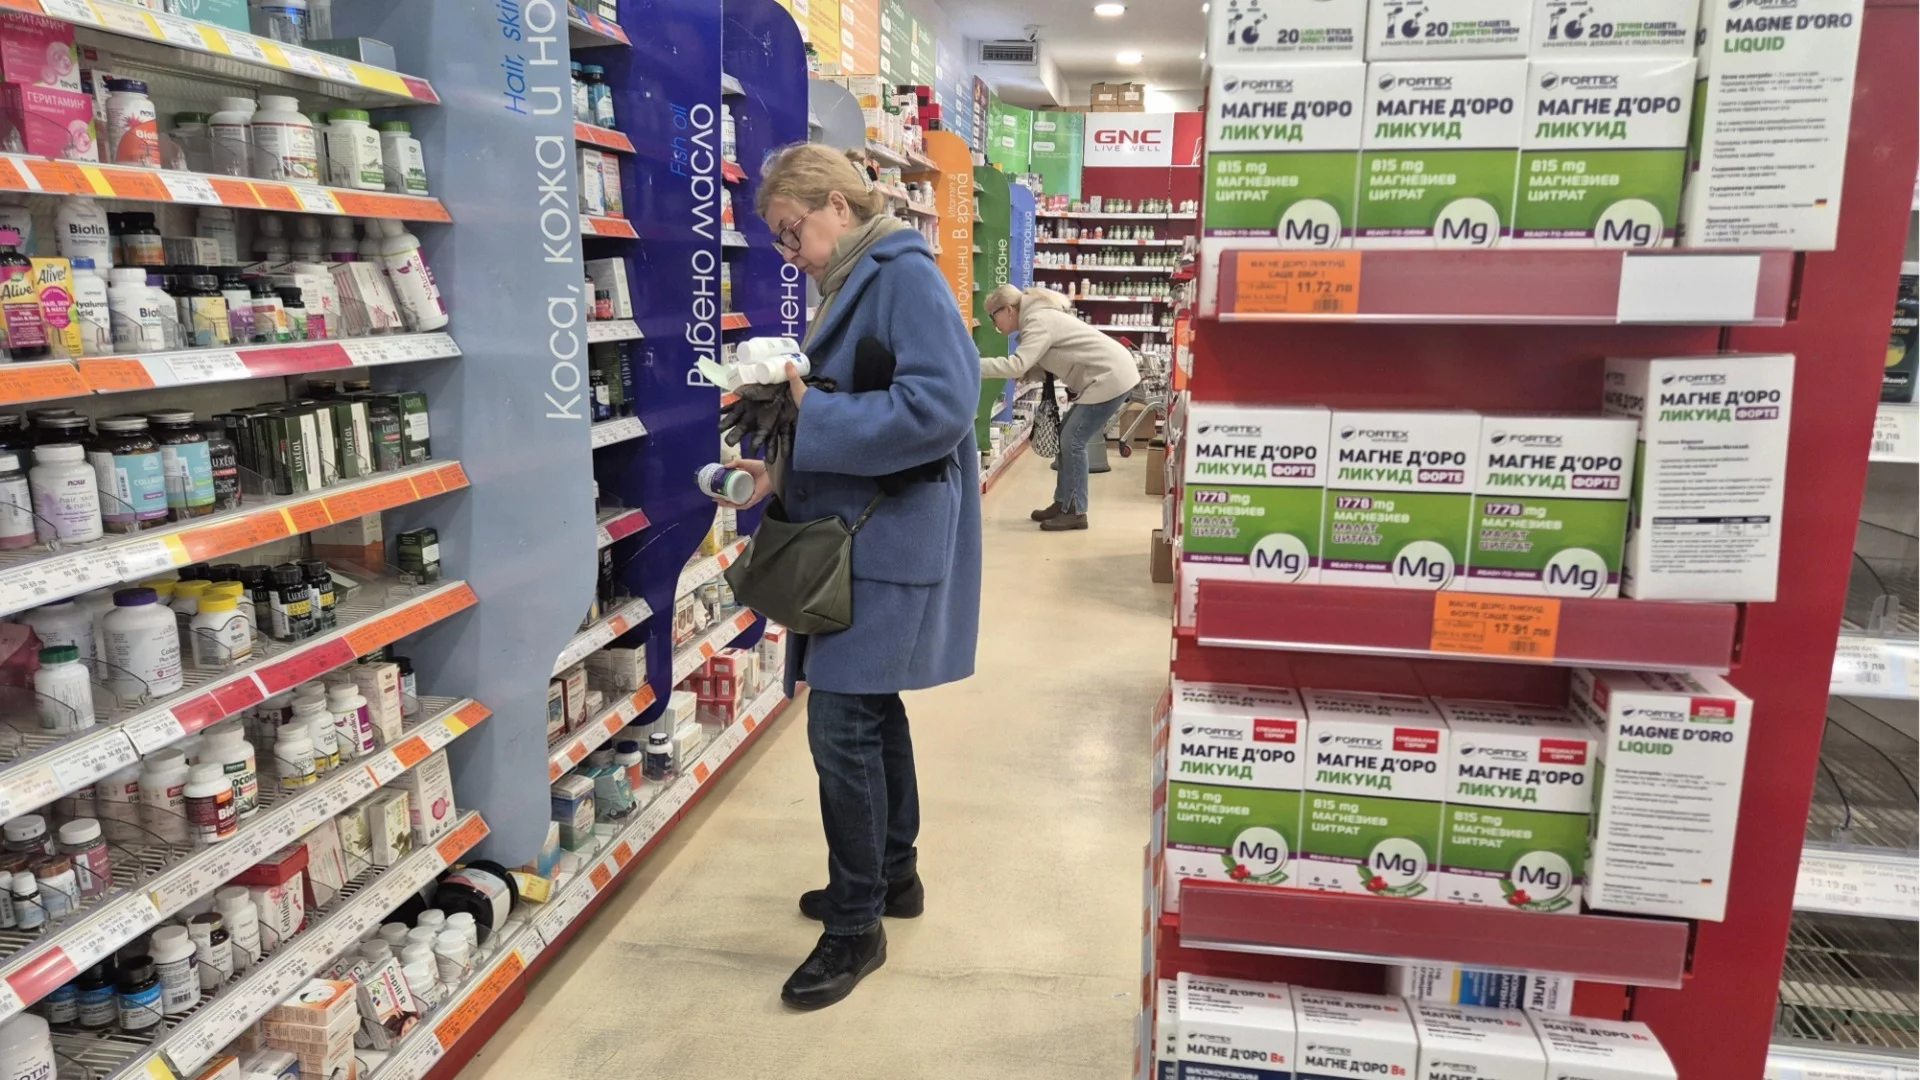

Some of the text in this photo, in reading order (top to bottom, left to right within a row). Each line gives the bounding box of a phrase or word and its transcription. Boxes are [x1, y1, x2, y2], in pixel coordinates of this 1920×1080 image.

[1425, 20, 1511, 38] 20 САШЕТА
[1589, 21, 1678, 39] 20 САШЕТА
[1725, 17, 1797, 34] MAGNE
[1277, 28, 1300, 44] 20
[1723, 36, 1785, 53] LIQUID
[504, 50, 528, 117] Hair,
[1241, 79, 1294, 90] FORTEX
[1398, 76, 1453, 89] FORTEX
[1561, 75, 1619, 87] FORTEX
[27, 91, 85, 110] ГЕРИТАМИН
[533, 86, 563, 116] и
[1376, 98, 1446, 117] МАГНЕ
[1537, 97, 1612, 116] МАГНЕ
[1221, 101, 1287, 119] МАГНЕ
[1094, 129, 1162, 144] GNC
[1220, 124, 1303, 143] ЛИКУИД
[1375, 121, 1462, 140] ЛИКУИД
[1535, 121, 1627, 140] ЛИКУИД
[669, 104, 688, 177] Fish oil
[690, 103, 715, 240] масло
[1217, 161, 1267, 175] 815 mg
[1371, 159, 1424, 174] 815 mg
[1531, 160, 1586, 175] 815 mg
[1216, 175, 1299, 188] МАГНЕЗИЕВ
[1369, 174, 1457, 187] МАГНЕЗИЕВ
[1529, 174, 1620, 188] МАГНЕЗИЕВ
[535, 135, 574, 264] кожа
[957, 173, 971, 224] група
[1216, 189, 1269, 202] ЦИТРАТ
[1368, 188, 1425, 201] ЦИТРАТ
[1528, 188, 1587, 202] ЦИТРАТ
[69, 223, 105, 236] Biotin
[1285, 219, 1330, 245] Mg
[1442, 218, 1488, 245] Mg
[1603, 219, 1652, 246] Mg
[1022, 211, 1033, 289] онцентрация
[37, 266, 67, 285] Alive!
[1297, 281, 1332, 294] 11.72
[1335, 284, 1353, 293] лв
[780, 262, 800, 338] нено
[545, 284, 583, 420] Коса,
[1678, 373, 1727, 384] FORTEX
[1660, 391, 1721, 407] МАГНЕ
[1658, 407, 1779, 423] ЛИКУИД ФОРТЕ
[1213, 425, 1263, 434] FORTEX
[1358, 429, 1409, 439] FORTEX
[1509, 434, 1564, 445] FORTEX
[1196, 444, 1257, 459] МАГНЕ
[1339, 449, 1403, 464] МАГНЕ
[1488, 454, 1557, 469] МАГНЕ
[1195, 462, 1315, 479] ЛИКУИД ФОРТЕ
[1337, 467, 1464, 485] ЛИКУИД ФОРТЕ
[68, 478, 86, 487] now
[1486, 472, 1620, 490] ЛИКУИД ФОРТЕ
[1195, 491, 1251, 506] 1778 mg
[1337, 496, 1396, 512] 1778 mg
[1192, 505, 1266, 517] МАГНЕЗИЕВ
[1334, 511, 1411, 524] МАГНЕЗИЕВ
[1485, 504, 1547, 518] 1778 mg
[1191, 526, 1240, 538] ЦИТРАТ
[1481, 518, 1562, 530] МАГНЕЗИЕВ
[1332, 533, 1383, 545] ЦИТРАТ
[1480, 540, 1534, 552] ЦИТРАТ
[1256, 548, 1300, 574] Mg
[1399, 556, 1446, 582] Mg
[1549, 564, 1598, 590] Mg
[1494, 623, 1552, 637] 17.91 лв
[1198, 727, 1244, 737] FORTEX
[1620, 724, 1680, 740] MAGNE
[1335, 736, 1383, 746] FORTEX
[1618, 740, 1674, 755] LIQUID
[1180, 743, 1239, 759] МАГНЕ
[1478, 747, 1529, 759] FORTEX
[1317, 752, 1377, 769] МАГНЕ
[1180, 761, 1254, 781] ЛИКУИД
[1458, 763, 1522, 781] МАГНЕ
[1316, 770, 1392, 791] ЛИКУИД
[1178, 789, 1223, 805] 815 mg
[1457, 782, 1538, 803] ЛИКУИД
[1177, 801, 1250, 816] МАГНЕЗИЕВ
[1313, 798, 1360, 814] 815 mg
[1177, 812, 1224, 825] ЦИТРАТ
[1312, 811, 1388, 826] МАГНЕЗИЕВ
[1454, 811, 1503, 826] 815 mg
[1312, 822, 1361, 835] ЦИТРАТ
[1453, 823, 1533, 840] МАГНЕЗИЕВ
[1452, 836, 1504, 849] ЦИТРАТ
[1239, 841, 1279, 864] Mg
[1376, 852, 1417, 876] Mg
[1519, 865, 1562, 891] Mg
[1809, 877, 1840, 889] 13.19
[1187, 984, 1228, 995] МАГНЕ
[1186, 1044, 1229, 1057] МАГНЕ
[1305, 1055, 1349, 1070] МАГНЕ
